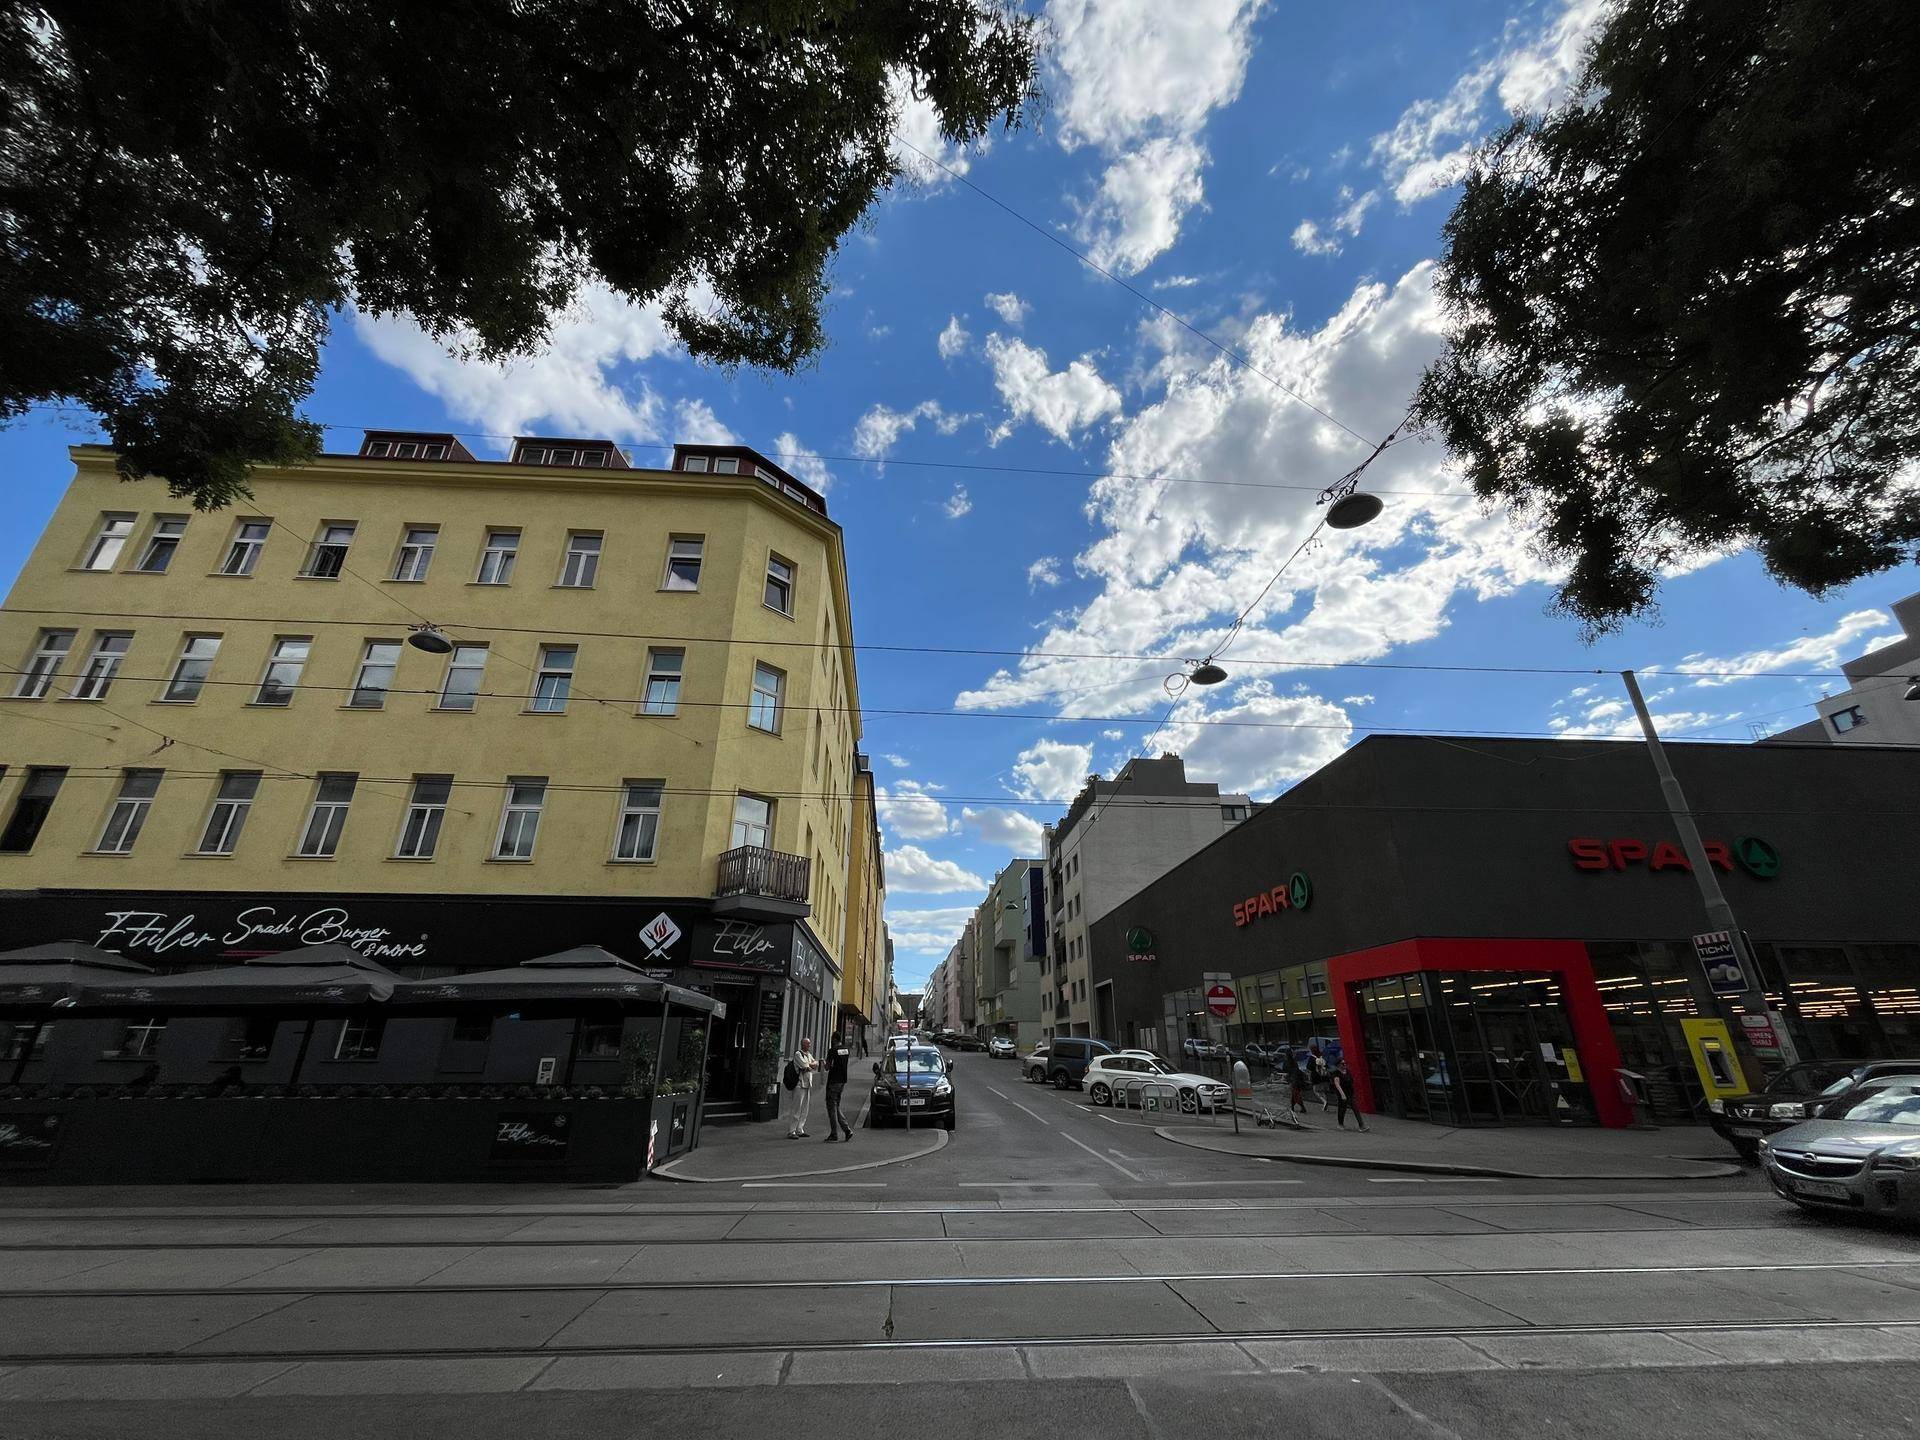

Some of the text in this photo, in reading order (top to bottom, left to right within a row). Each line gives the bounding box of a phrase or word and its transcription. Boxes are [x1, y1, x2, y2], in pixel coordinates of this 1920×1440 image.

[1568, 837, 1736, 872] SPAR
[1233, 885, 1289, 927] SPAR
[222, 906, 294, 945] Smash
[299, 908, 391, 949] Burger
[1128, 954, 1156, 962] SPAR
[1698, 944, 1731, 955] TICHY
